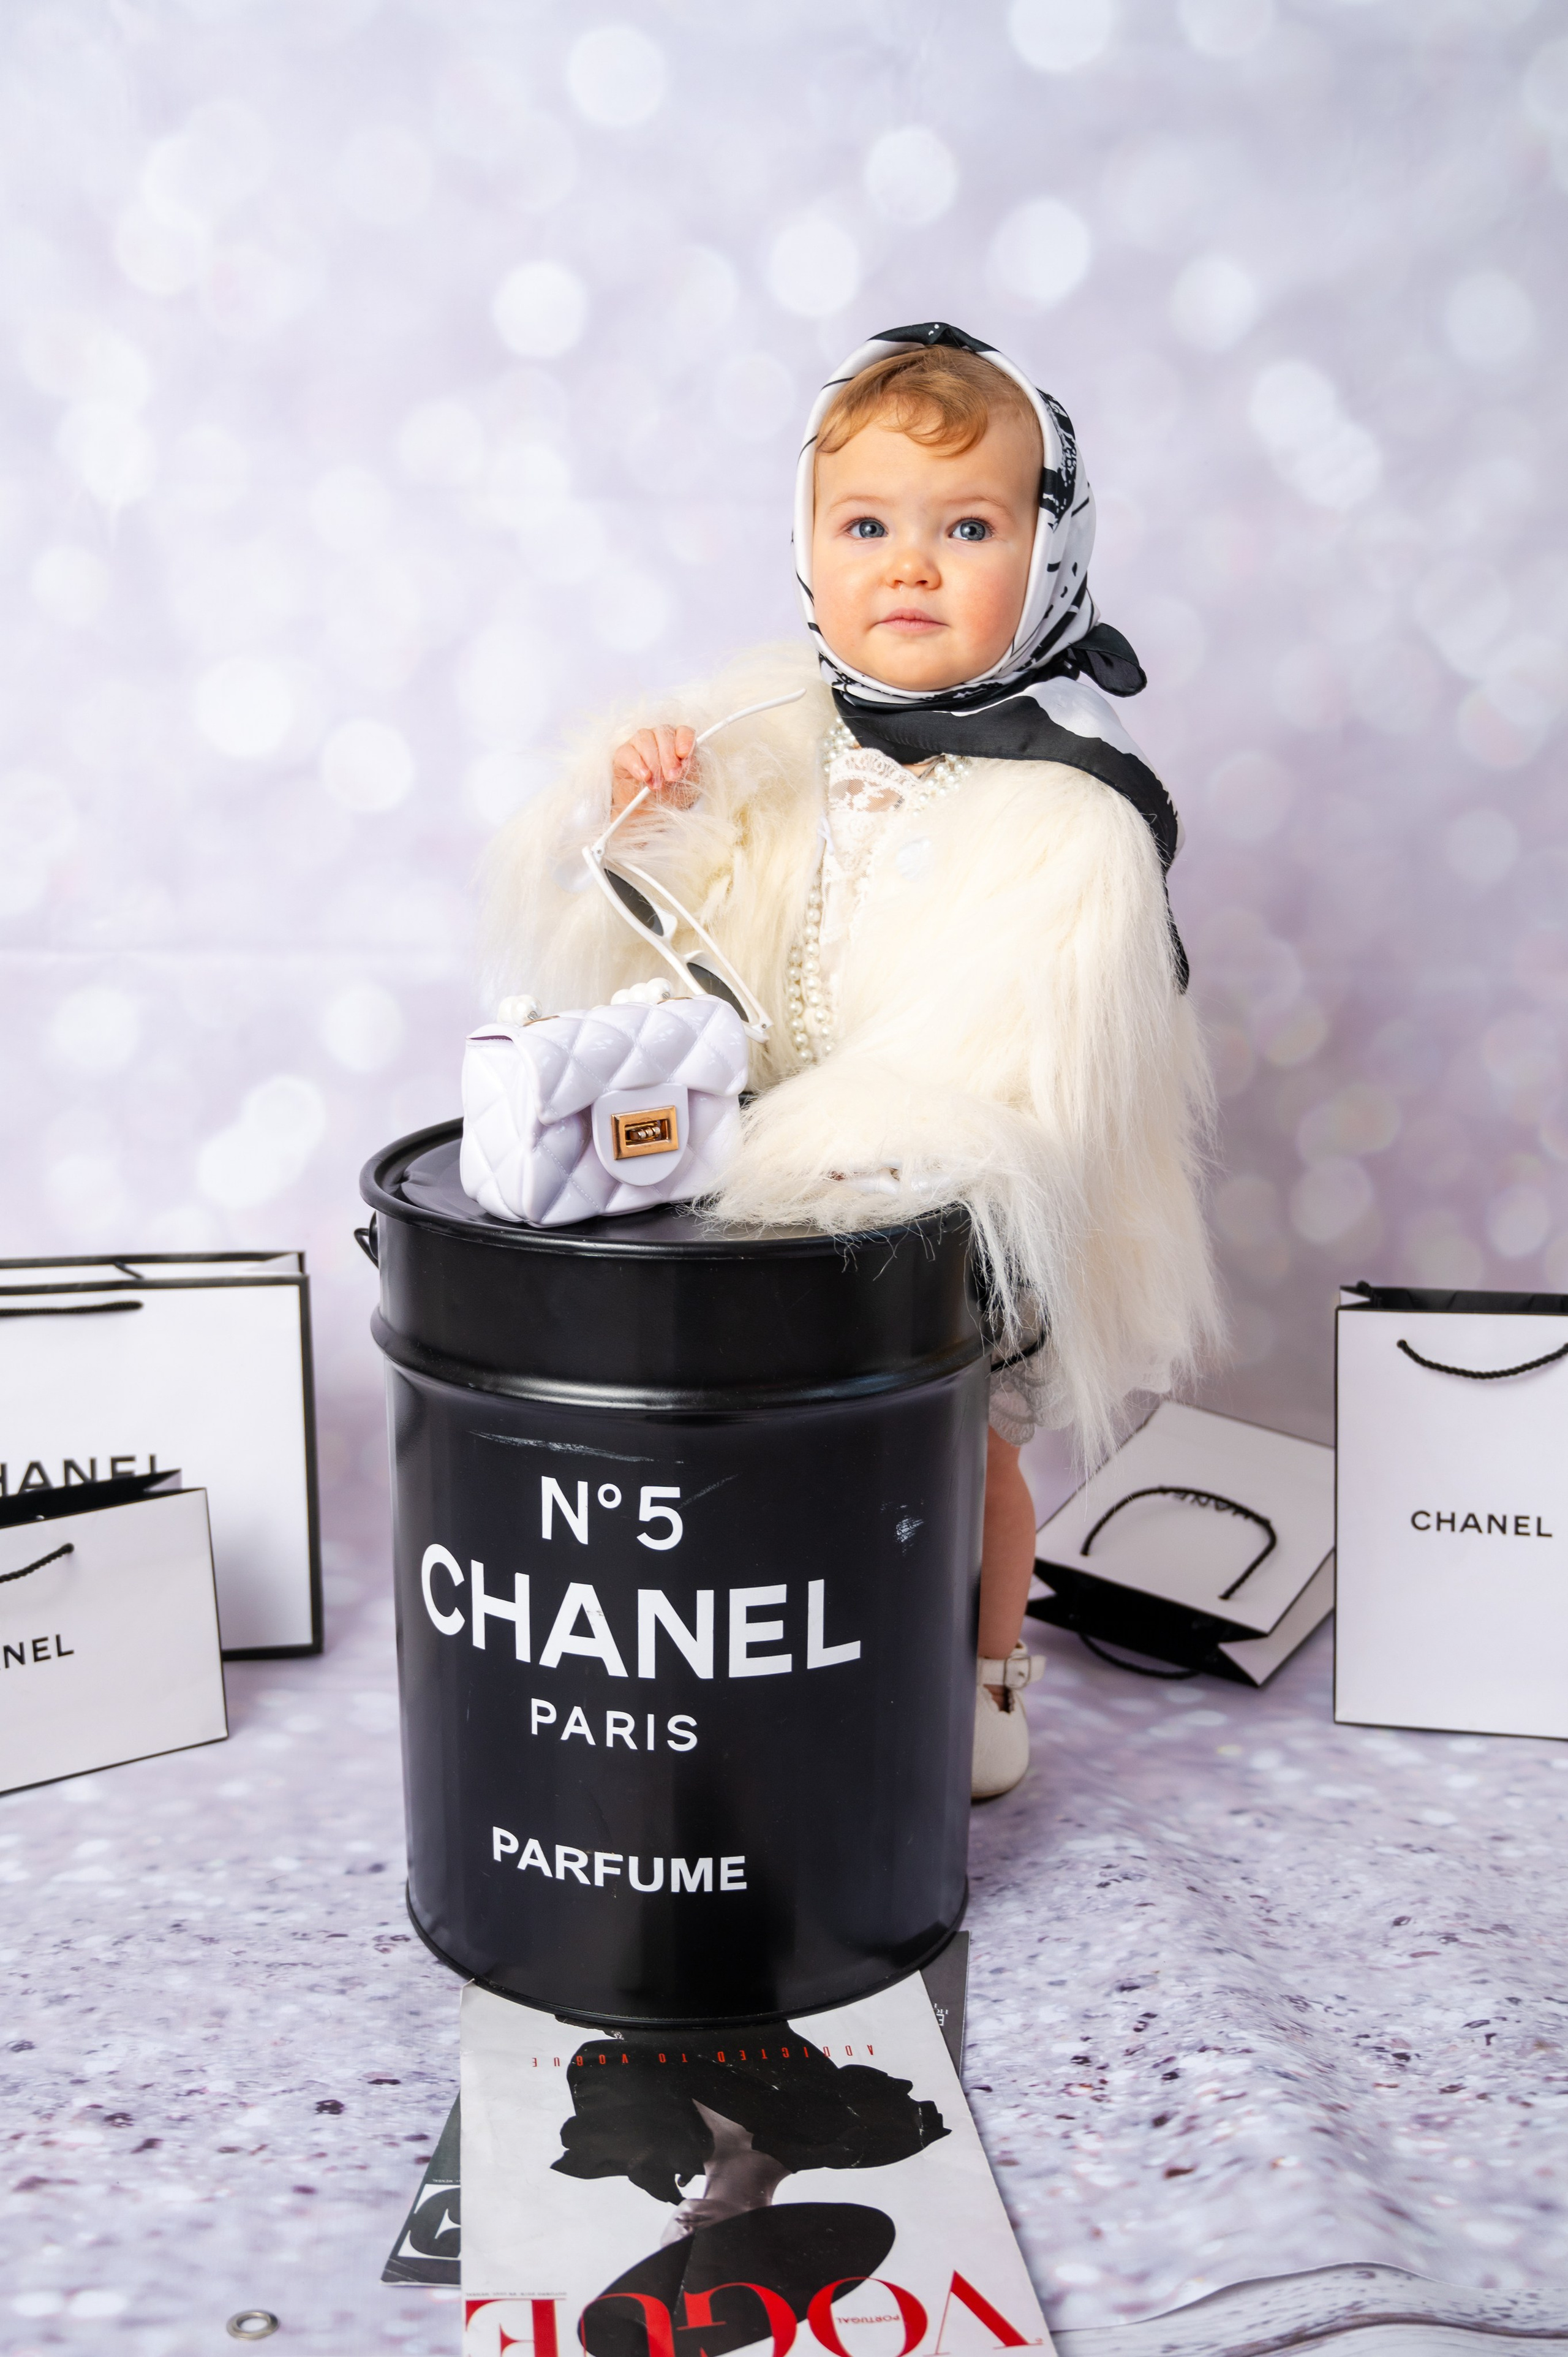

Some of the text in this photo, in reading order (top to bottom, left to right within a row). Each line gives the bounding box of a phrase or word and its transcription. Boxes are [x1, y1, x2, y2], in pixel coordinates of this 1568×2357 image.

[1410, 1510, 1553, 1538] CHANEL
[421, 1543, 861, 1680] CHANEL
[2, 1634, 75, 1669] NEL
[531, 1698, 698, 1752] PARIS
[492, 1826, 747, 1893] PARFUME
[532, 2044, 875, 2067] ADDICTED TO VOGUE
[465, 2269, 1035, 2357] VOGUE
[835, 2314, 899, 2324] PORTUGAL
